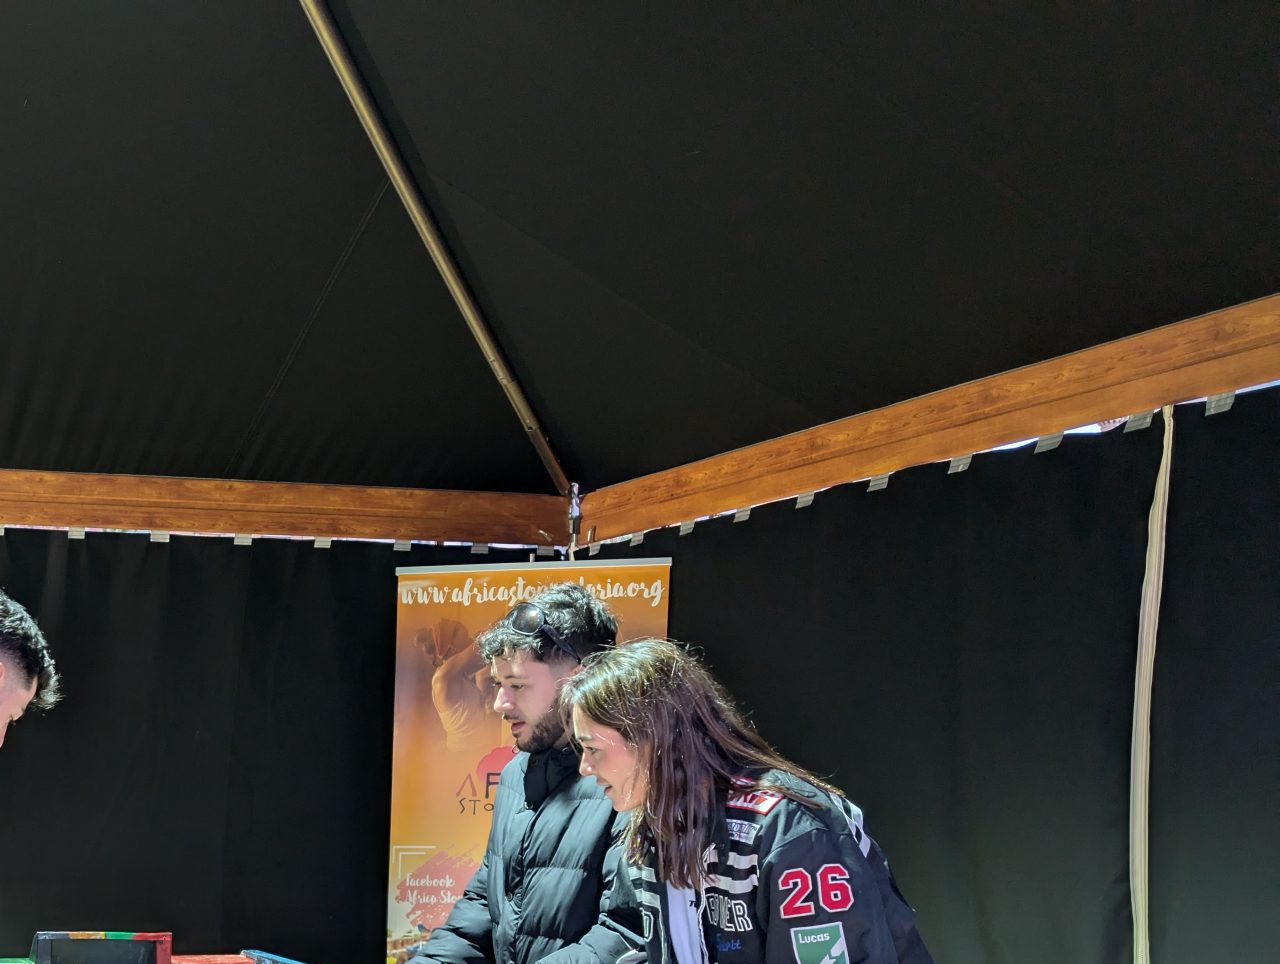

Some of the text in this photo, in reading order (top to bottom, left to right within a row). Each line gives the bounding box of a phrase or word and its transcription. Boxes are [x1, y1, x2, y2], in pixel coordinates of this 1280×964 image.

[459, 797, 494, 815] STO
[405, 873, 455, 889] Facebook
[778, 863, 854, 919] 26
[798, 932, 831, 944] Lucas
